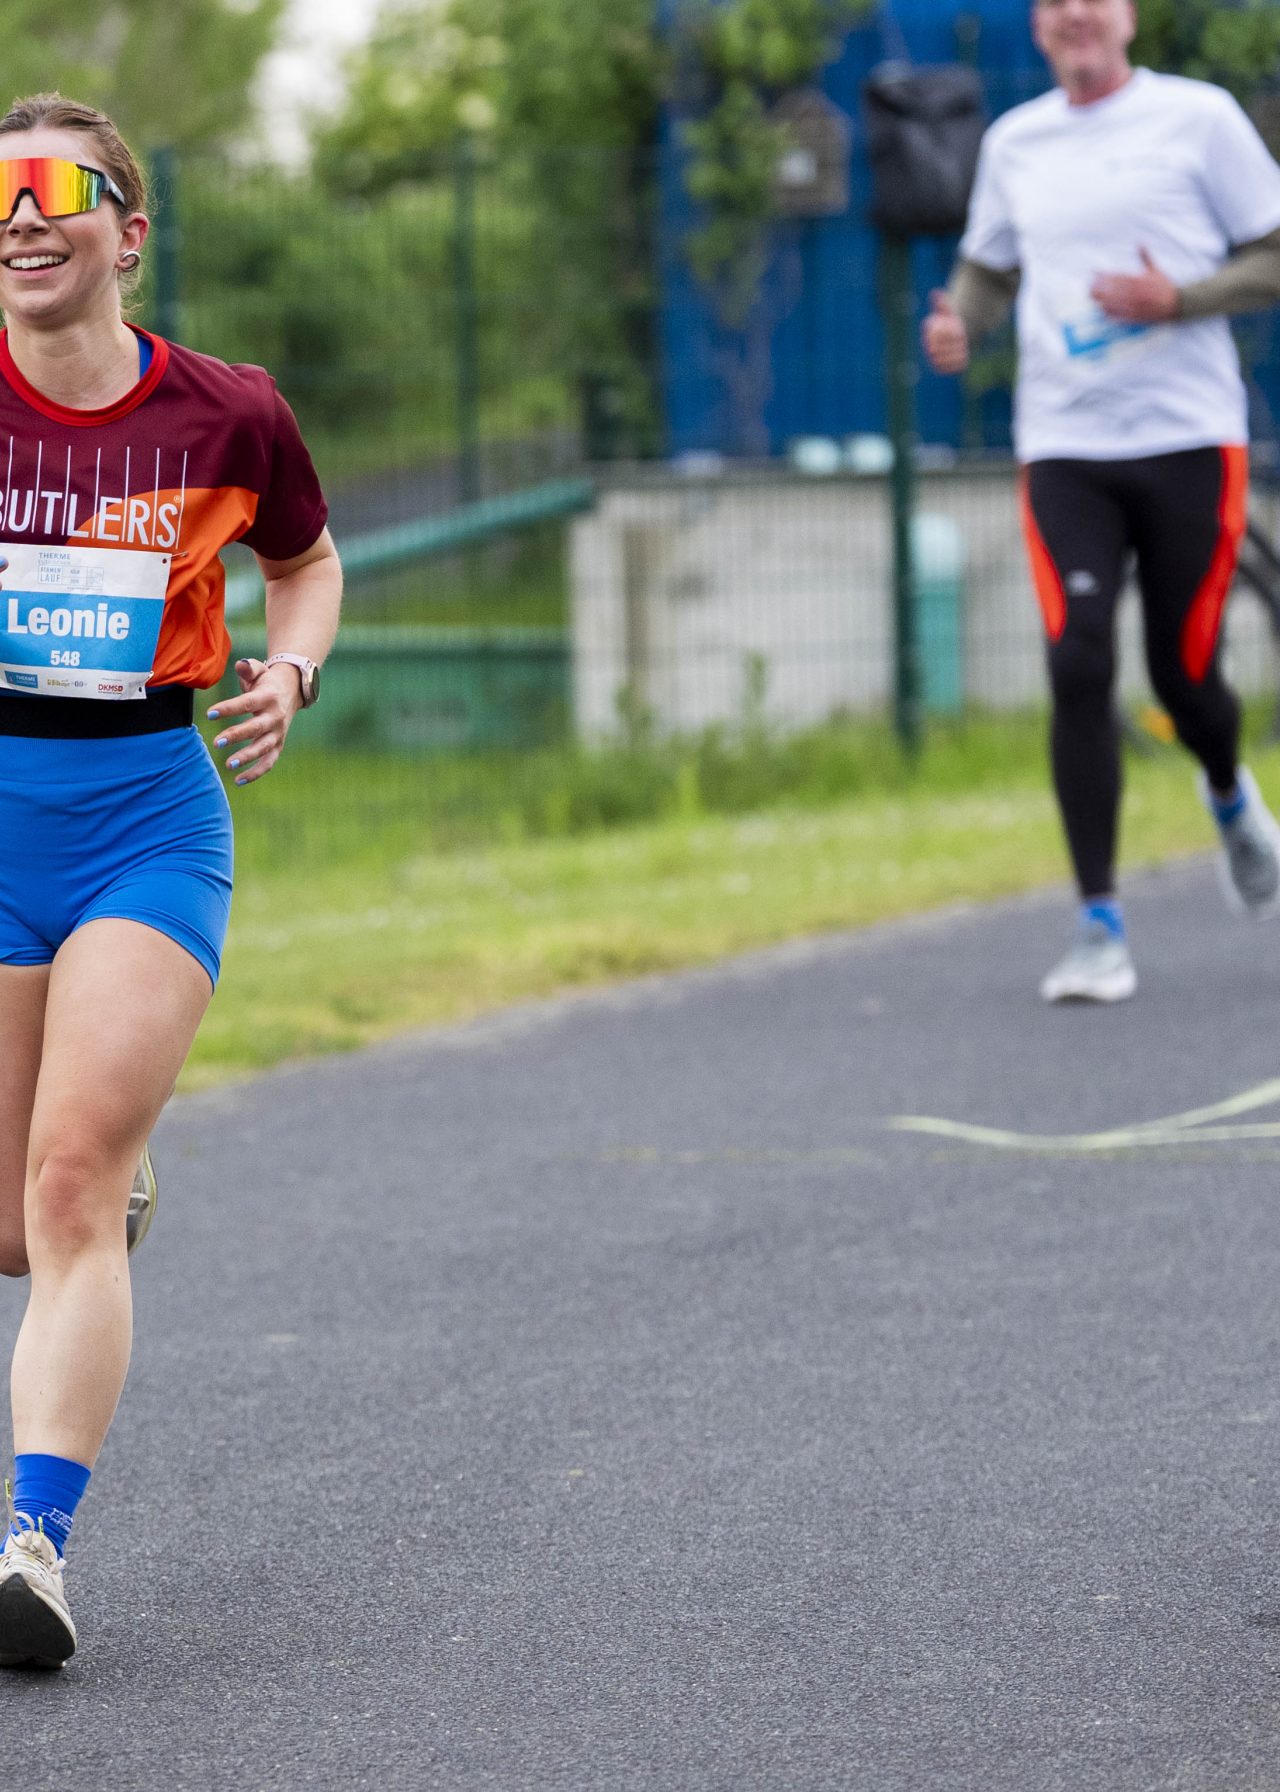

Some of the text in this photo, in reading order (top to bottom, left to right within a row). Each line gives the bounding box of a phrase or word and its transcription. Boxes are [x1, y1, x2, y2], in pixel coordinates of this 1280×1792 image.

[39, 552, 71, 560] THERME
[40, 573, 61, 583] LAUF
[7, 598, 130, 640] Leonie
[50, 650, 81, 667] 548
